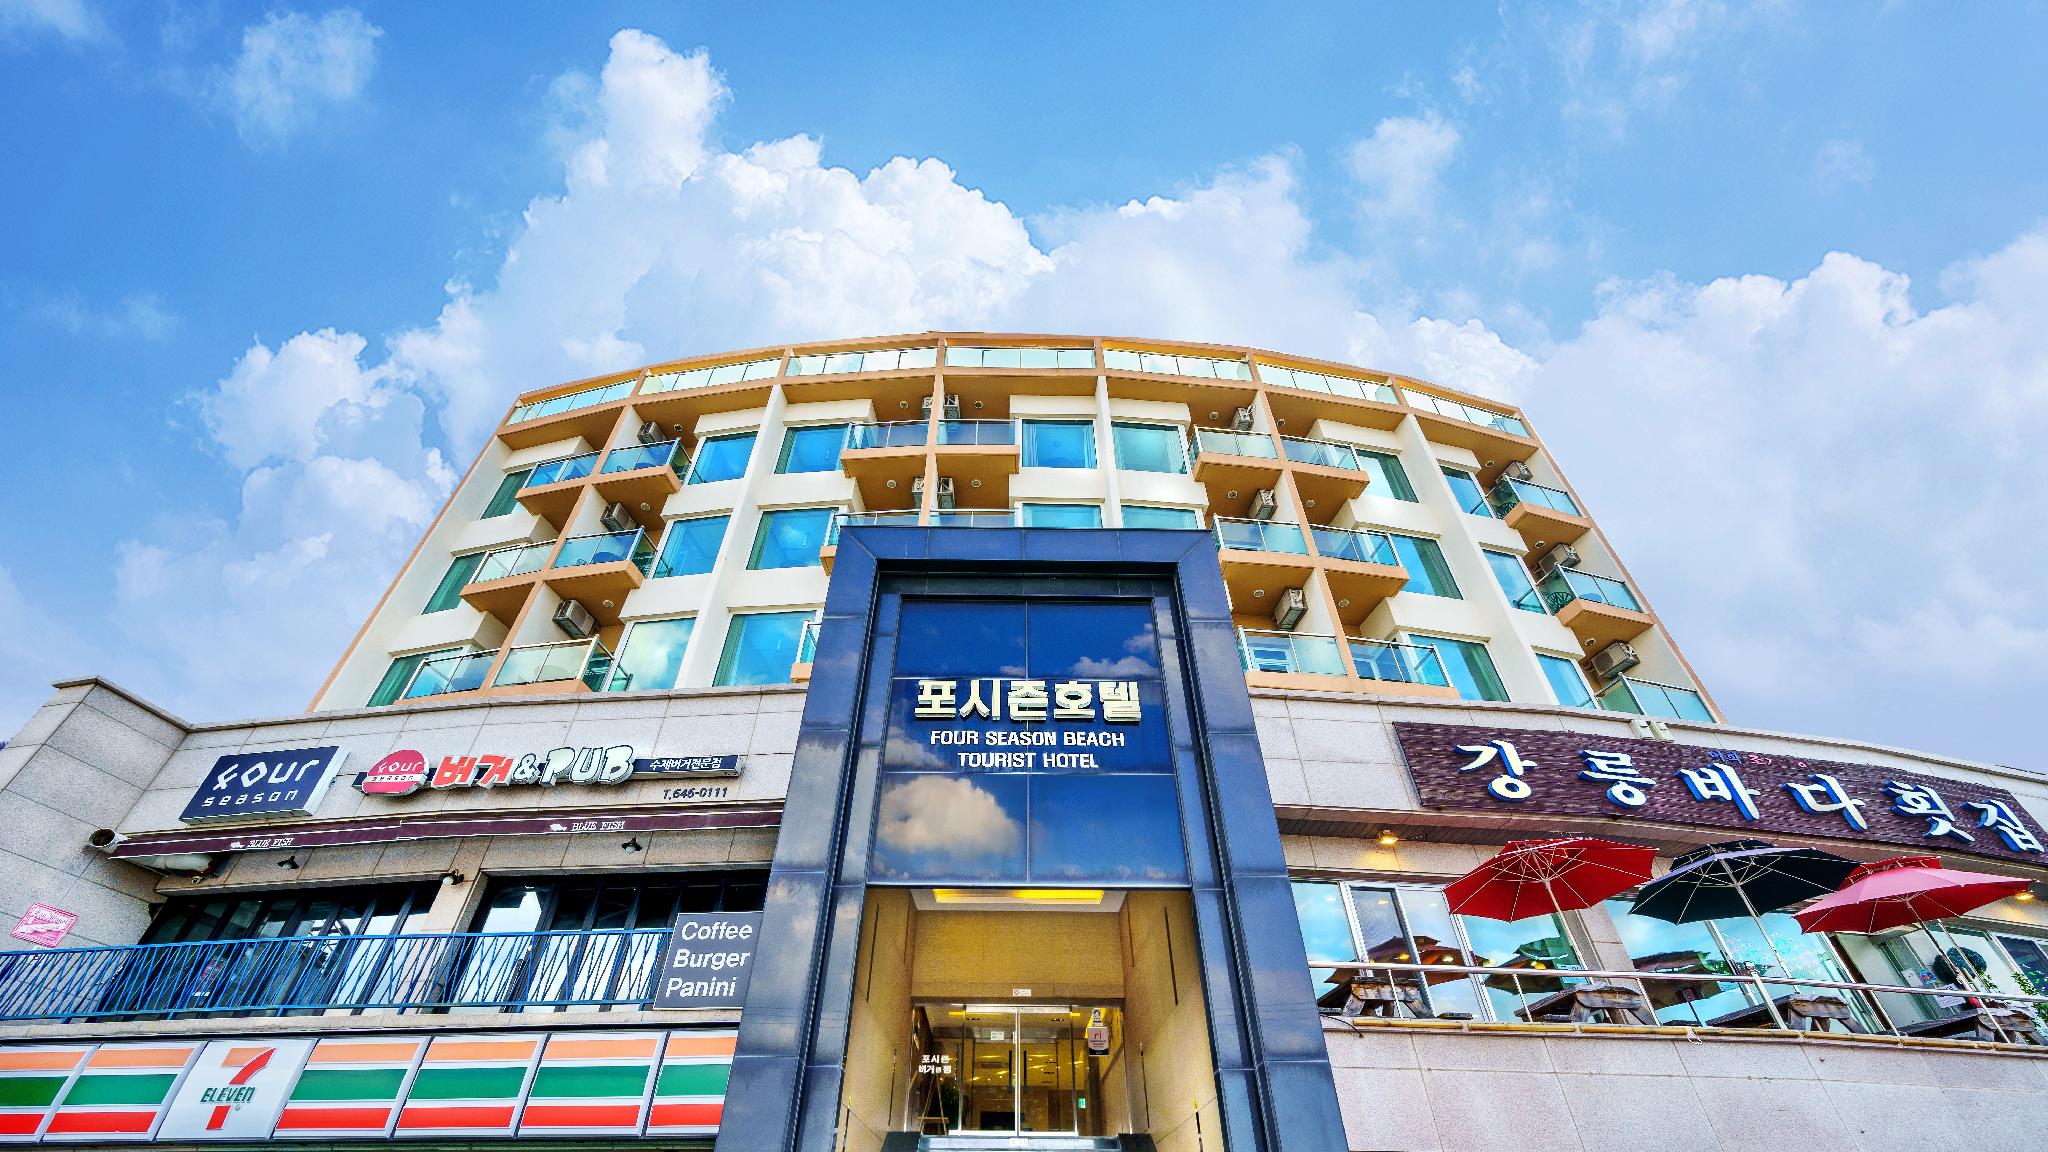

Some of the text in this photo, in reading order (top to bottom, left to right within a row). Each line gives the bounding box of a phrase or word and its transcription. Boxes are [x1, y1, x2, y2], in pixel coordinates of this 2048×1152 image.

[930, 731, 1125, 747] FOUR SEASON BEACH
[649, 757, 722, 771] 수제버거전문점
[958, 753, 1099, 769] TOURIST HOTEL
[201, 789, 299, 808] season
[571, 820, 625, 832] BLUE FISH
[681, 921, 753, 941] Coffee
[672, 948, 751, 971] Burger
[665, 976, 738, 998] Panini
